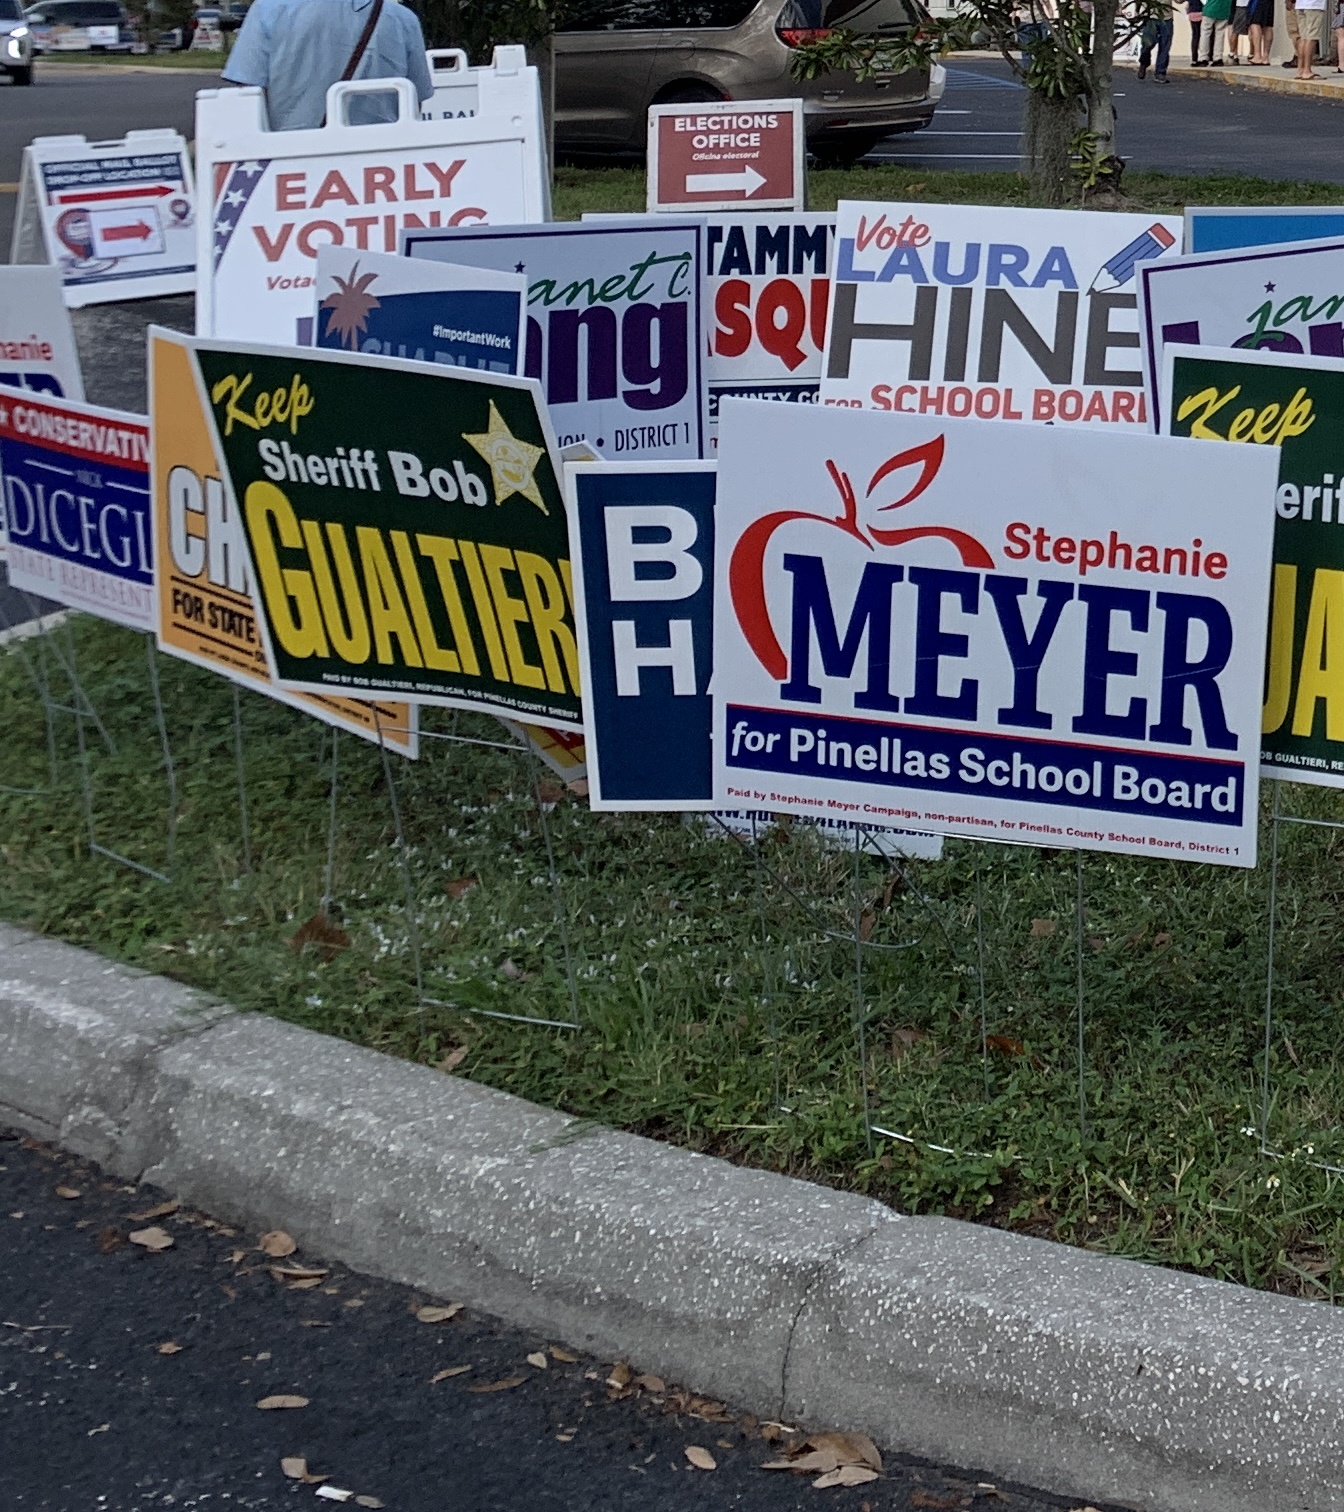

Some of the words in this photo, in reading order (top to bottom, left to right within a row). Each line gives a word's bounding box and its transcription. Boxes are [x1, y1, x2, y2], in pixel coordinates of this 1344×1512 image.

[674, 114, 778, 132] ELECTIONS
[692, 133, 761, 149] OFFICE
[722, 150, 760, 161] electoral
[275, 159, 468, 212] EARLY
[707, 225, 837, 276] TAMM
[855, 214, 931, 252] Vote
[527, 251, 692, 306] anet
[836, 238, 1080, 289] LAURA
[432, 324, 512, 350] #ImportantWork
[525, 301, 689, 410] ng
[213, 373, 315, 436] Keep
[871, 384, 1023, 420] SCHOOL
[1175, 384, 1316, 447] Keep
[12, 405, 150, 464] CONSERVATIV
[615, 423, 678, 451] DISTRICT
[684, 422, 690, 444] 1
[257, 437, 381, 492] Sheriff
[386, 449, 489, 507] Bob
[5, 475, 155, 574] DICEGL
[1003, 522, 1228, 581] Stephanie
[60, 562, 153, 614] REPRESENT
[172, 588, 206, 624] FOR
[207, 601, 255, 645] STATE
[780, 552, 1239, 752] MEYER
[731, 721, 781, 757] for
[789, 728, 950, 782] Pinellas
[958, 751, 1101, 800] School
[1112, 764, 1237, 814] Board
[1260, 752, 1273, 761] OB
[1274, 752, 1330, 770] GUALTIERI,
[727, 787, 751, 798] Paid
[753, 791, 767, 802] by
[770, 792, 824, 807] Stephanie
[827, 799, 860, 813] Meyer
[863, 804, 922, 820] Campaign,
[924, 811, 998, 829] non-partisan,
[1000, 819, 1016, 830] for
[1019, 822, 1063, 835] Pinellas
[1066, 827, 1105, 842] County
[1108, 832, 1145, 845] School
[1149, 837, 1185, 851] Board,
[1188, 842, 1230, 855] District
[1233, 847, 1240, 856] 1
